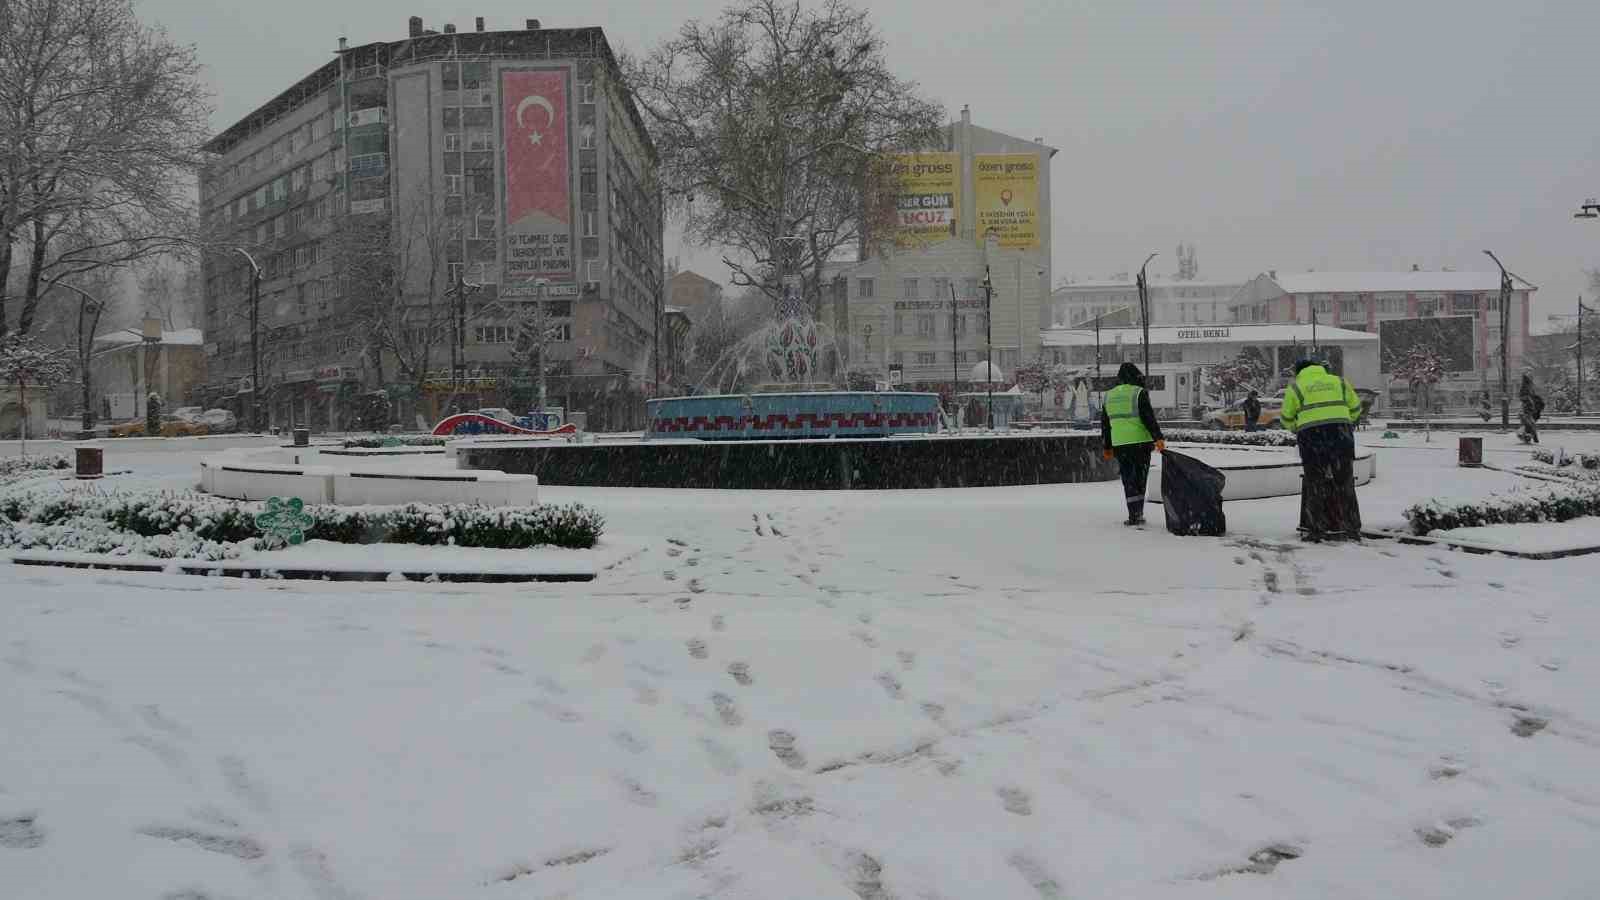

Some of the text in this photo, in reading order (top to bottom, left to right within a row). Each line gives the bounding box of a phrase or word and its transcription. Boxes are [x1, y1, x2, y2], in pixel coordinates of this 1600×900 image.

[912, 163, 953, 177] gross
[922, 194, 949, 207] GÜN
[903, 211, 945, 224] UCUZ
[1177, 328, 1201, 339] OTEL
